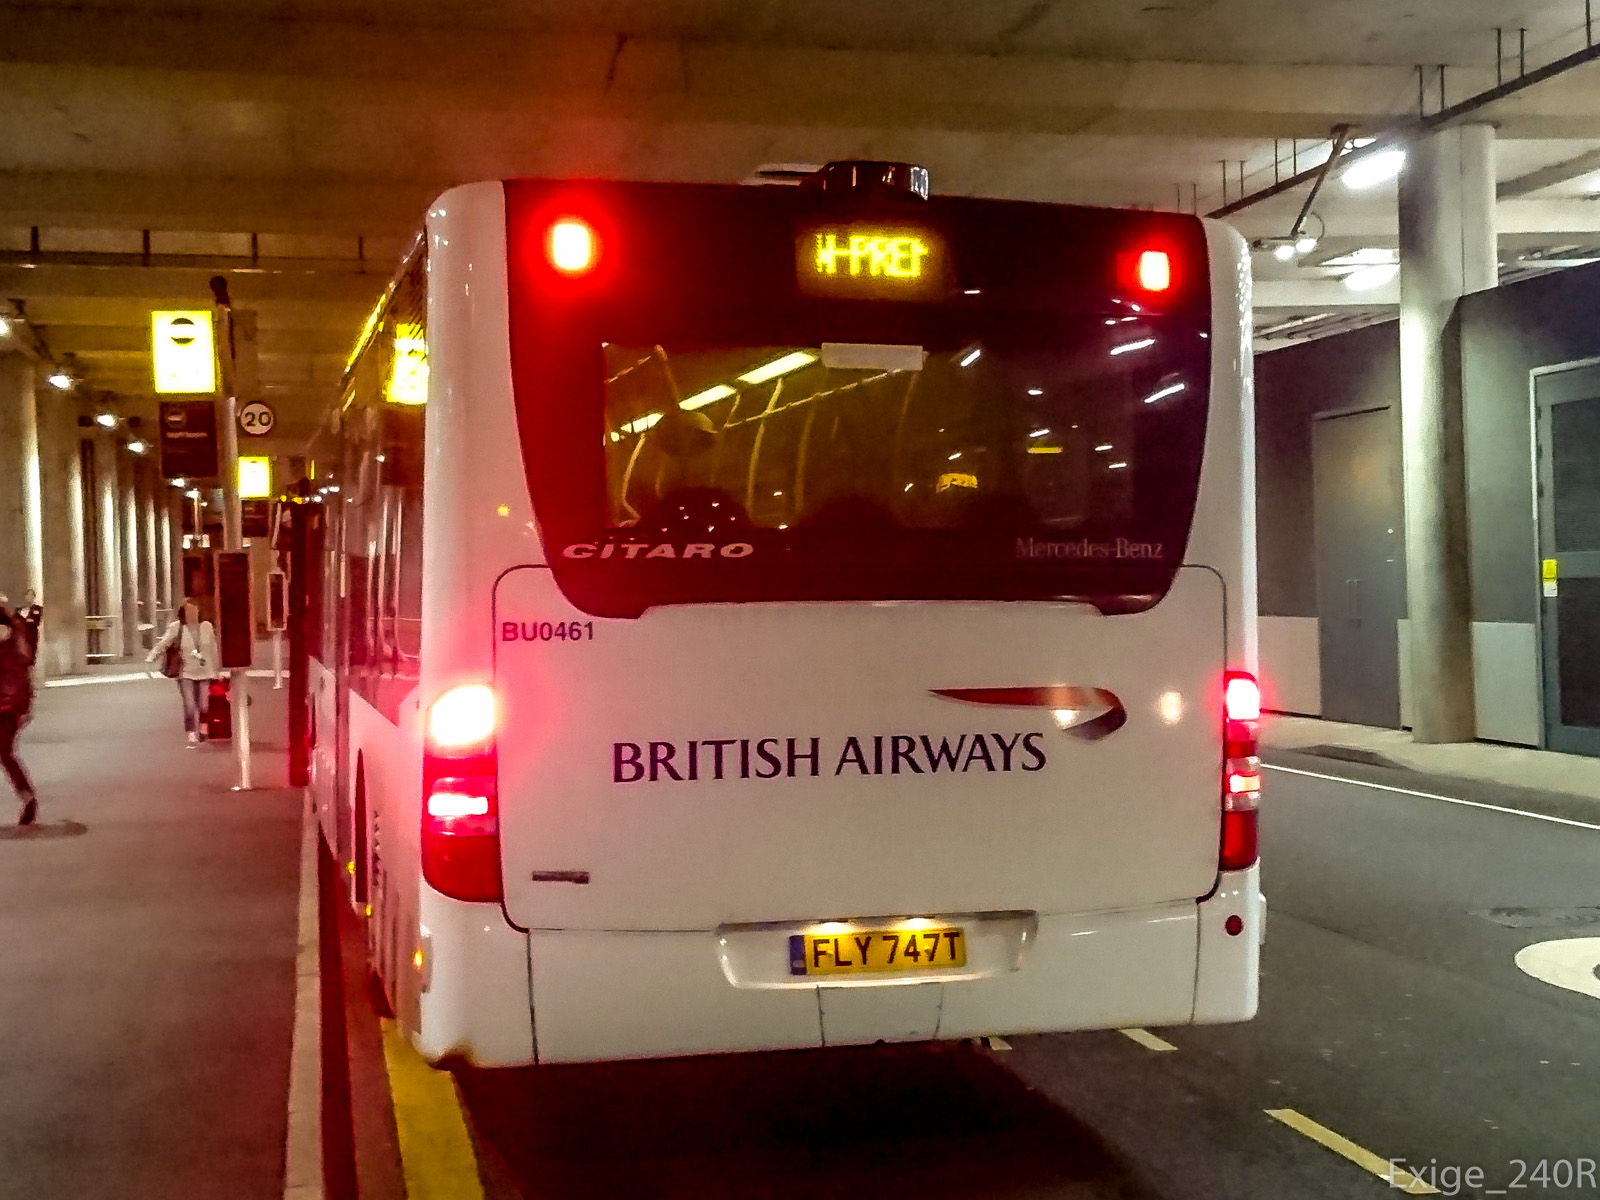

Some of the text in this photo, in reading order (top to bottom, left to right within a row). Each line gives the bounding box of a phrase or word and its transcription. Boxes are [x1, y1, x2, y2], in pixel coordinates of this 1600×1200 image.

[245, 412, 271, 426] 20
[561, 542, 755, 559] CITARO
[1015, 537, 1164, 560] Mercedes-Benz
[502, 620, 594, 642] BU0461
[612, 732, 1048, 783] BRITISH AIRWAYS
[812, 931, 961, 968] FLY 747T
